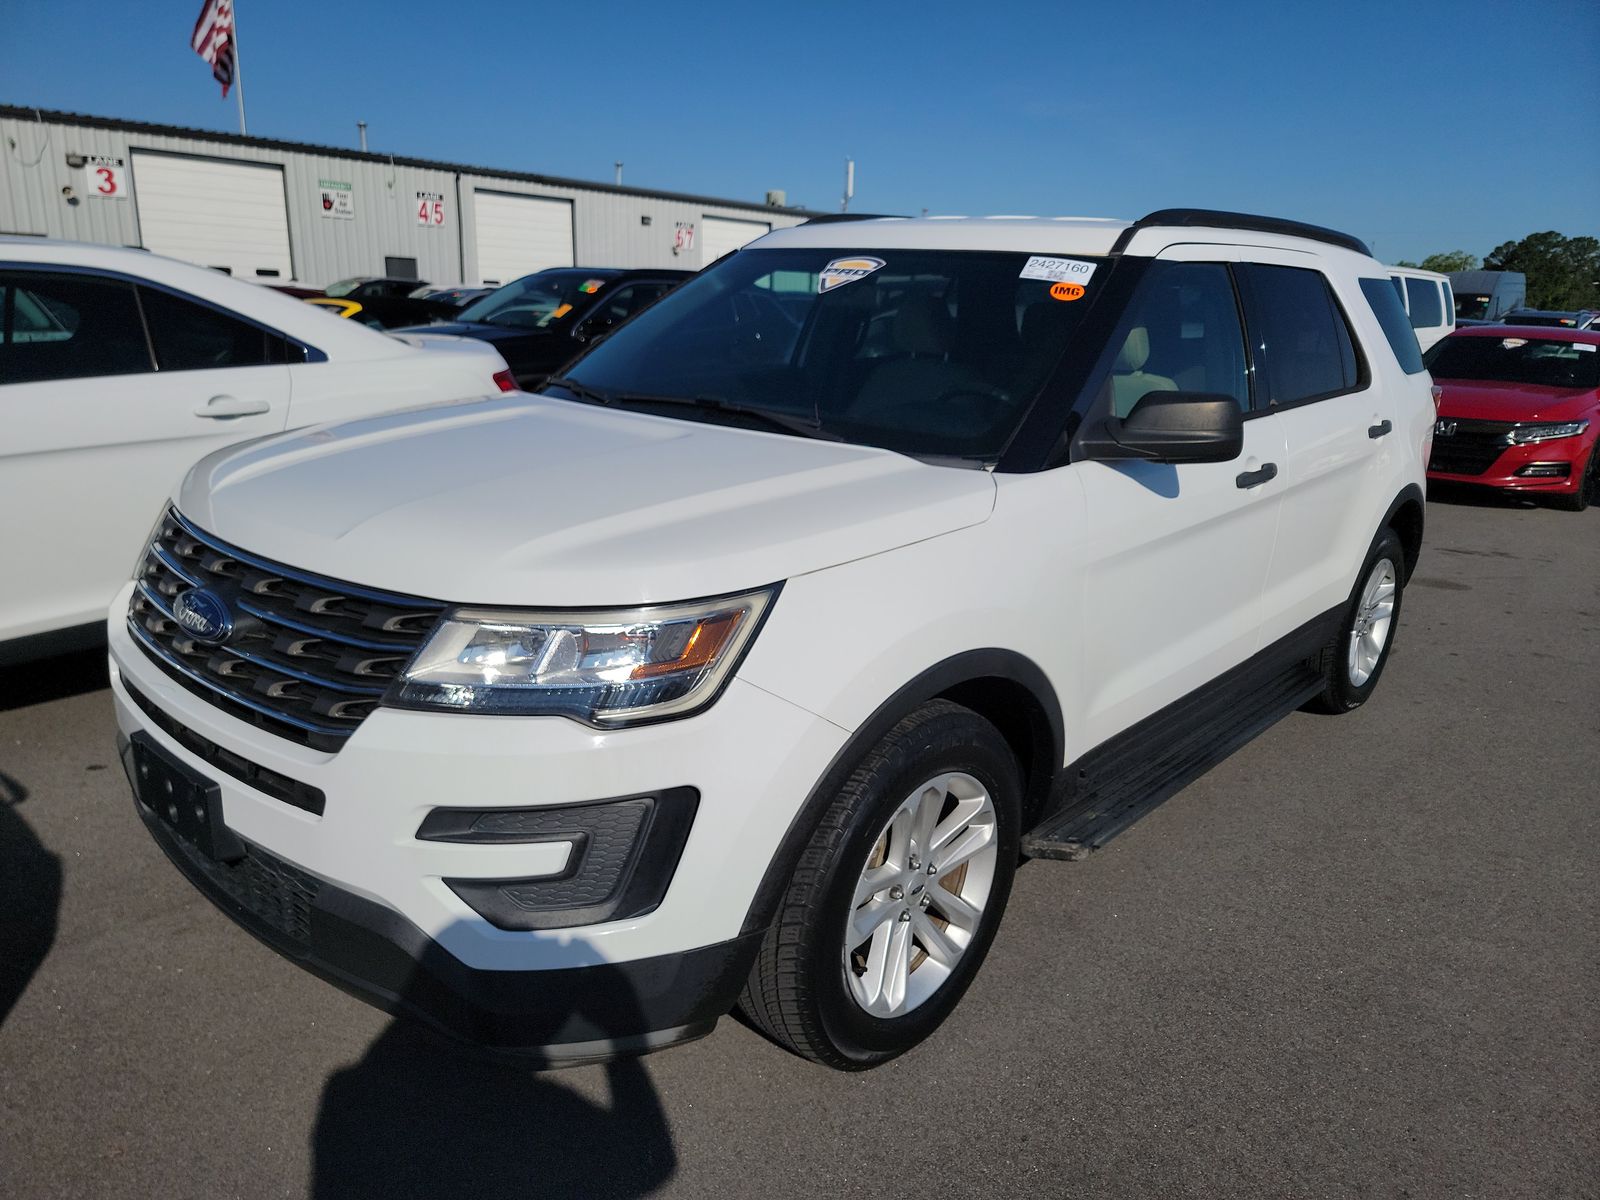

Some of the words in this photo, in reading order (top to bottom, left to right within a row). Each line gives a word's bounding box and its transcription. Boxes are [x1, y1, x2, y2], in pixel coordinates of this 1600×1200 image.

[96, 168, 117, 195] 3
[419, 201, 444, 224] 4/5
[1029, 259, 1089, 274] 2427160
[1054, 286, 1080, 296] IMG
[179, 595, 212, 632] Ford
